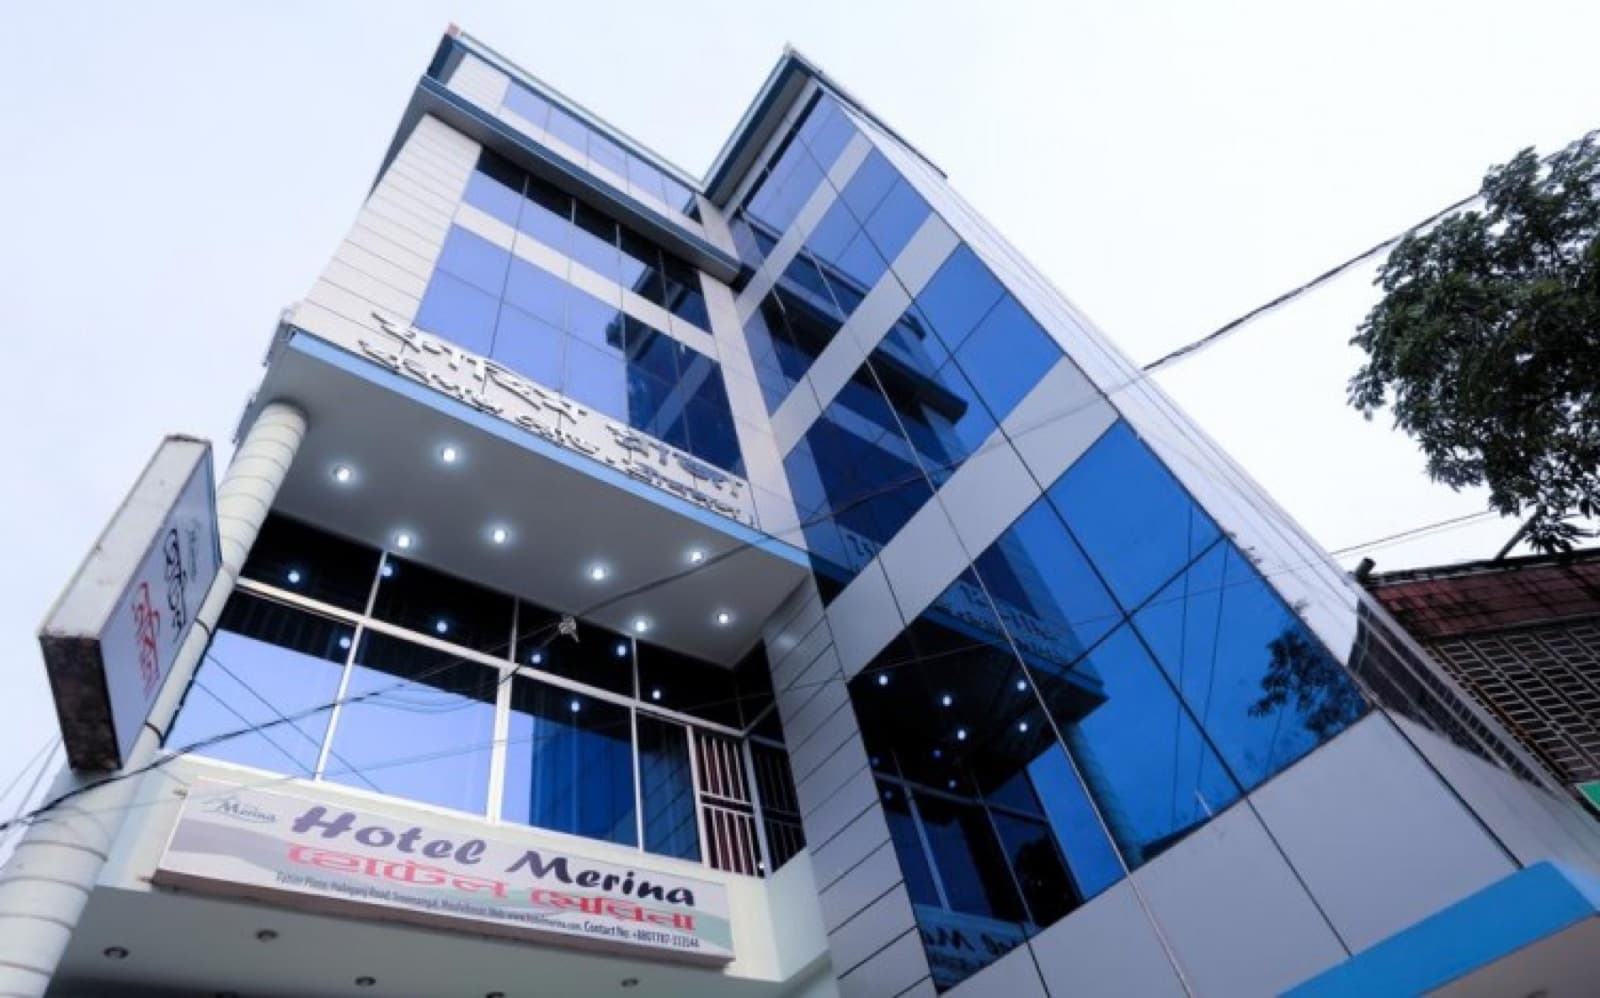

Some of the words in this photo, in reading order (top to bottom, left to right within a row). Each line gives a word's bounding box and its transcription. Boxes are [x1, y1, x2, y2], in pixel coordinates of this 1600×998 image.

[286, 841, 508, 898] হোটেল
[530, 886, 695, 930] মেরিনা
[292, 806, 487, 865] Hotel
[505, 850, 695, 906] Merina
[583, 920, 615, 937] Contact
